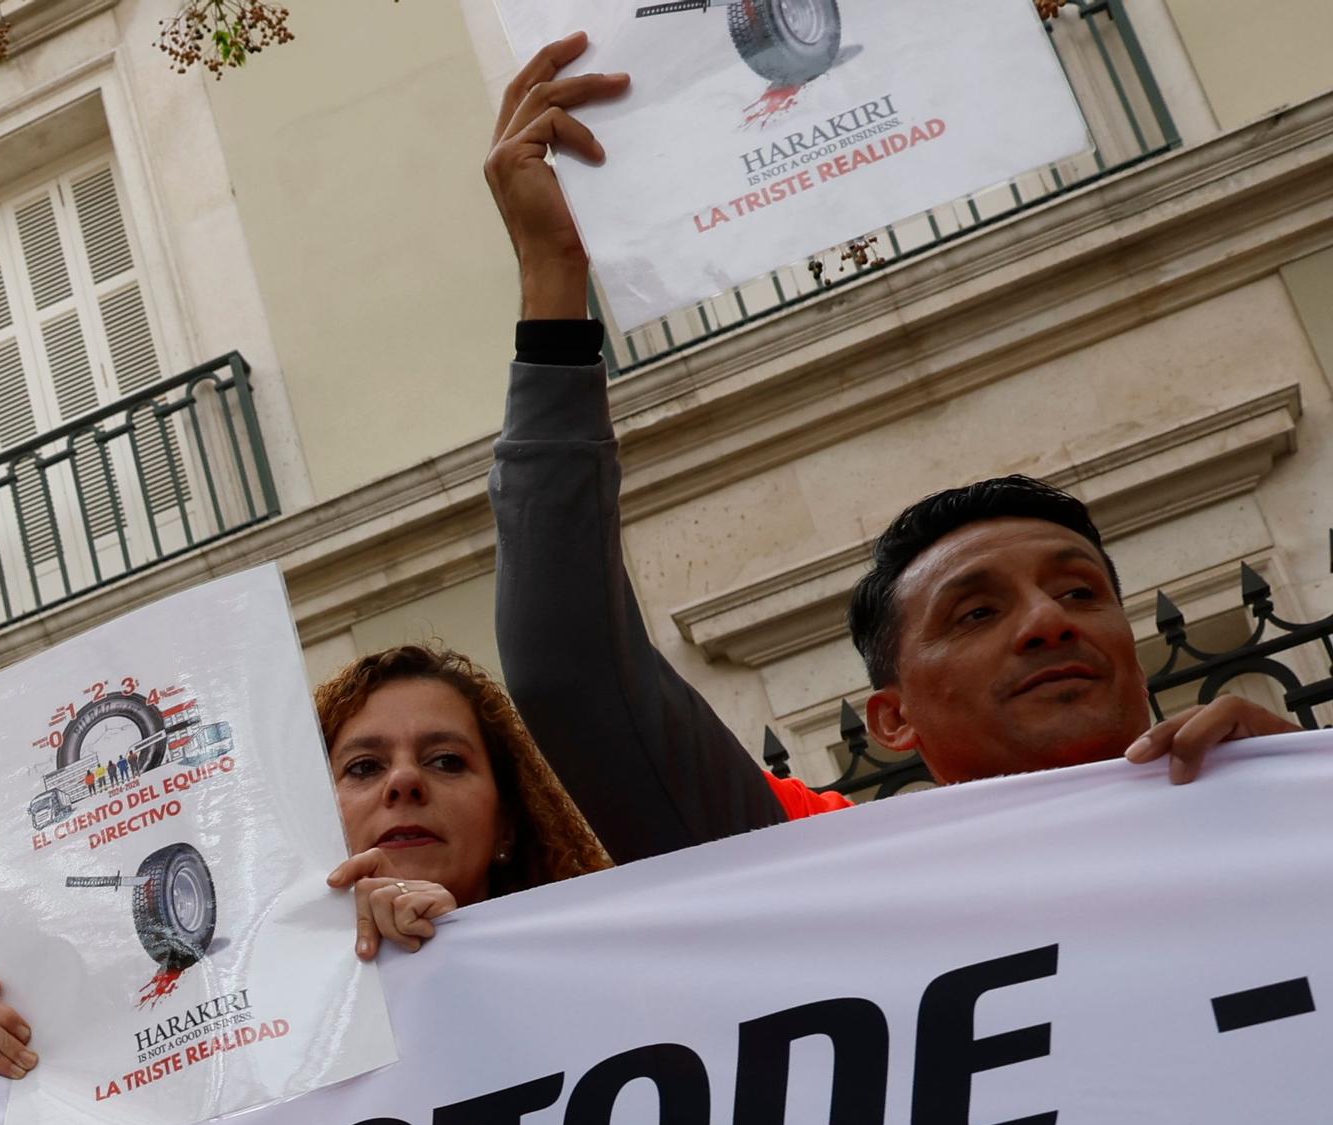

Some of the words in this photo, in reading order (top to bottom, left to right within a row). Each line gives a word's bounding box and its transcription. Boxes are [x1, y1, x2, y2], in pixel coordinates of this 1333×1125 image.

[740, 95, 899, 174] HARAKIRI
[747, 173, 761, 186] IS
[762, 163, 788, 180] NOT
[802, 143, 838, 165] GOOD
[839, 117, 903, 148] BUSINESS.
[693, 206, 730, 233] LA
[728, 171, 814, 216] TRISTE
[816, 118, 948, 183] REALIDAD
[33, 832, 52, 850] EL
[54, 800, 123, 840] CUENTO
[127, 784, 160, 809] DEL
[163, 756, 236, 792] EQUIPO
[88, 800, 182, 850] DIRECTIVO
[134, 989, 253, 1052] HARAKIRI
[138, 1053, 147, 1063] IS
[148, 1048, 167, 1060] NOT
[175, 1029, 202, 1047] GOOD
[95, 1080, 121, 1101] LA
[123, 1052, 183, 1091] TRISTE
[185, 1018, 290, 1066] REALIDAD
